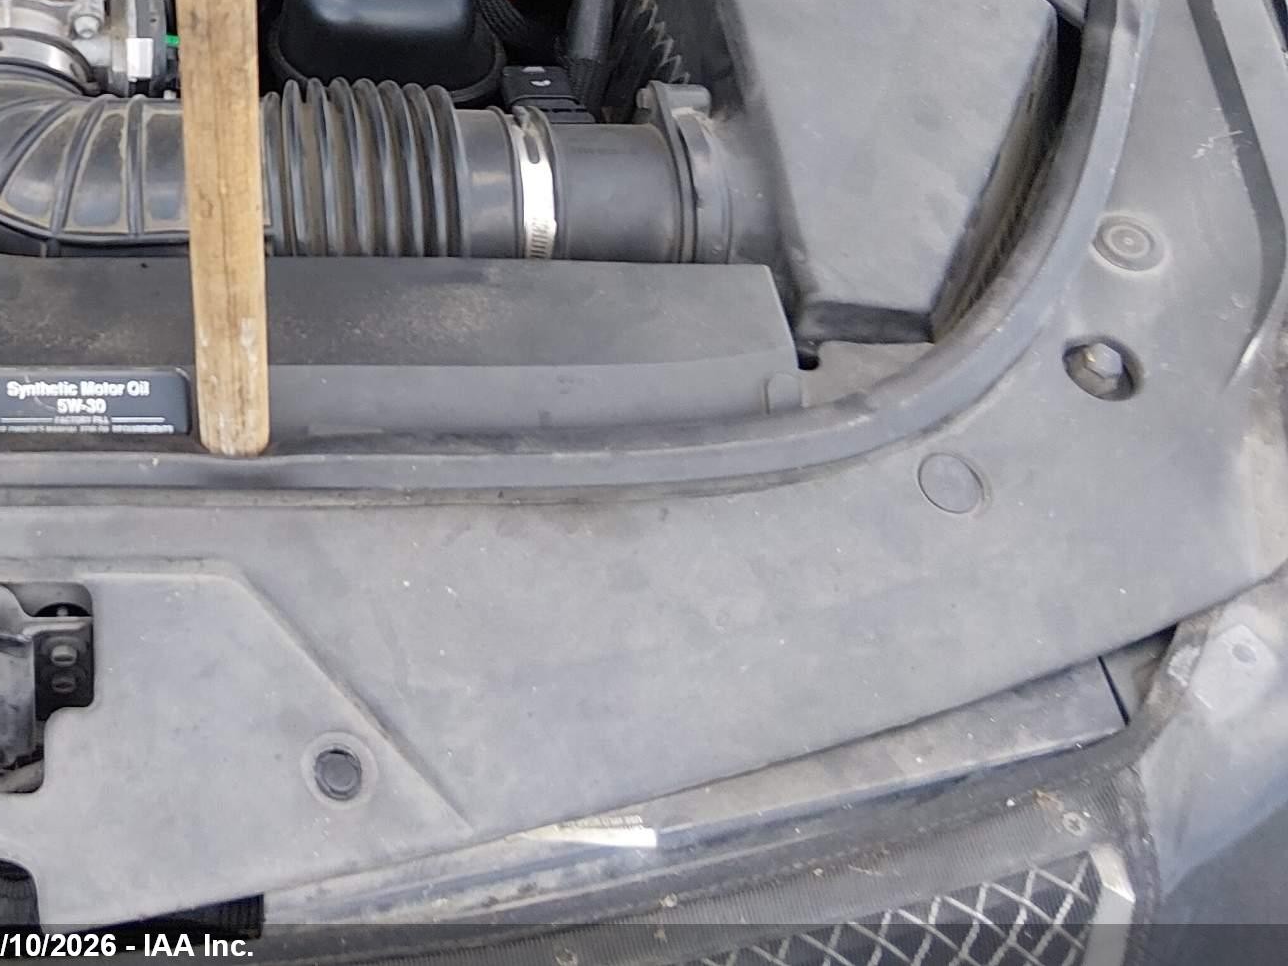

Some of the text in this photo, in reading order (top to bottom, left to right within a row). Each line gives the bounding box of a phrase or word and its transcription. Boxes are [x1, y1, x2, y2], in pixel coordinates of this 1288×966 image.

[7, 381, 150, 400] Synthetic Motor Oil
[57, 398, 107, 413] 5W-30
